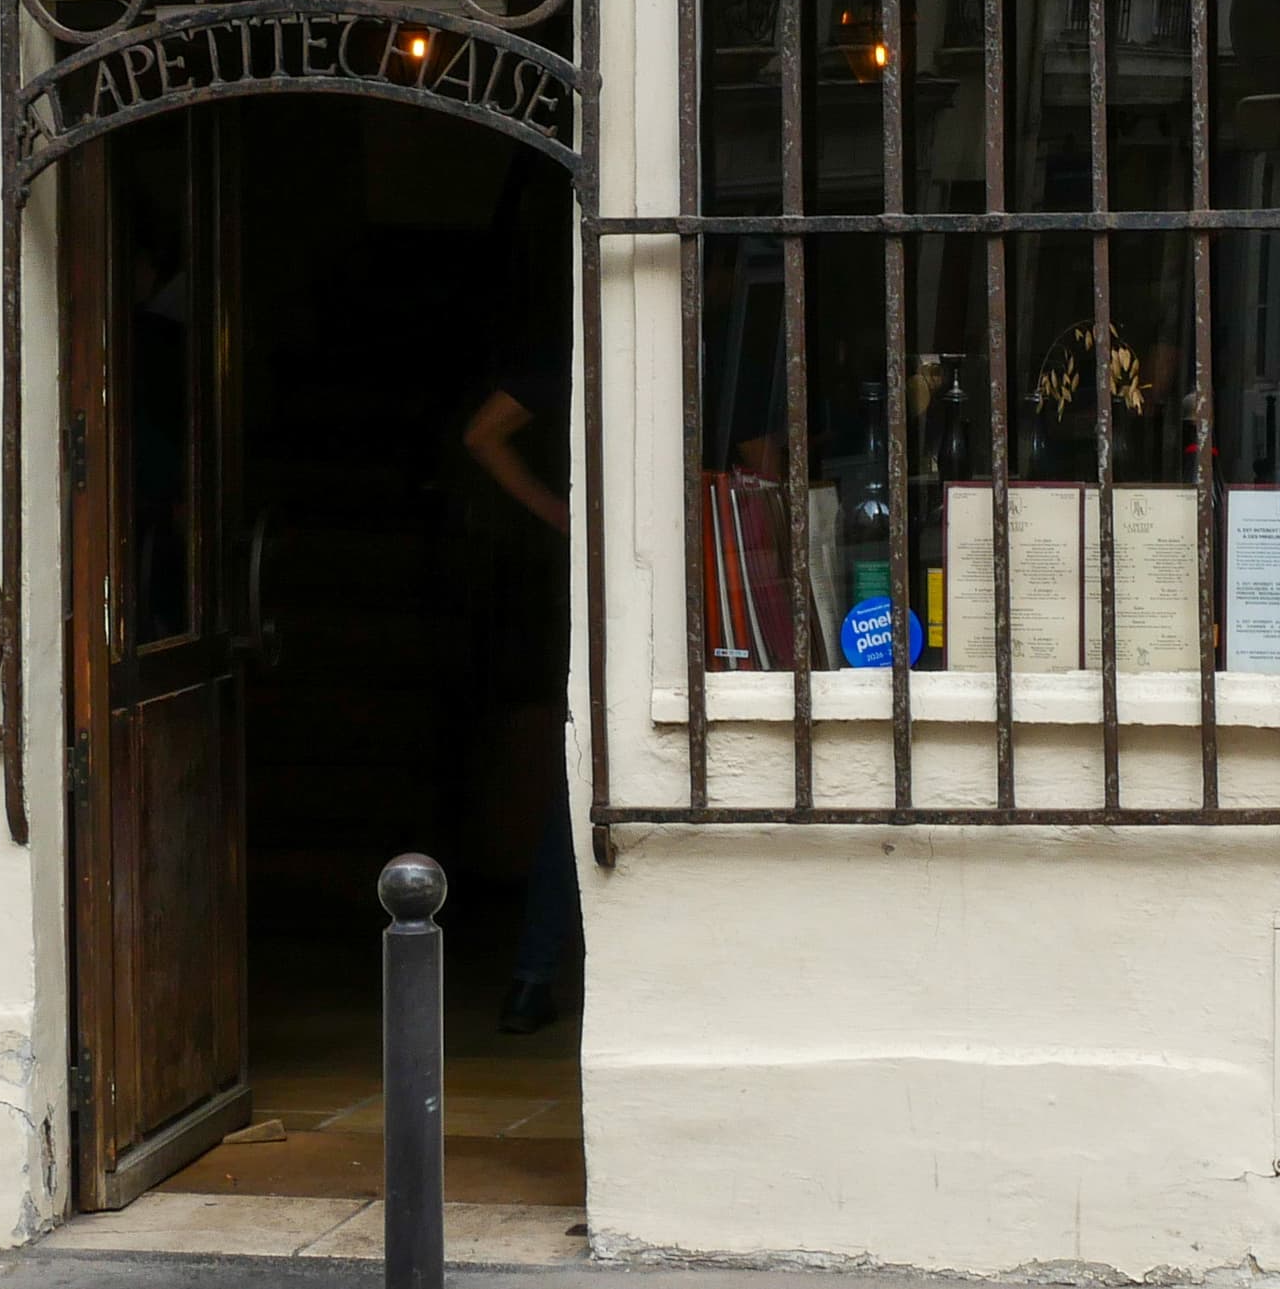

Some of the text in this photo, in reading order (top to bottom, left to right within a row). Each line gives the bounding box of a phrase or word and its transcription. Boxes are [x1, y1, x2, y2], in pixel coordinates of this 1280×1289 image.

[122, 13, 338, 105] PETITE
[337, 16, 571, 138] CHAISE
[851, 610, 892, 634] lonel
[856, 631, 892, 654] plan
